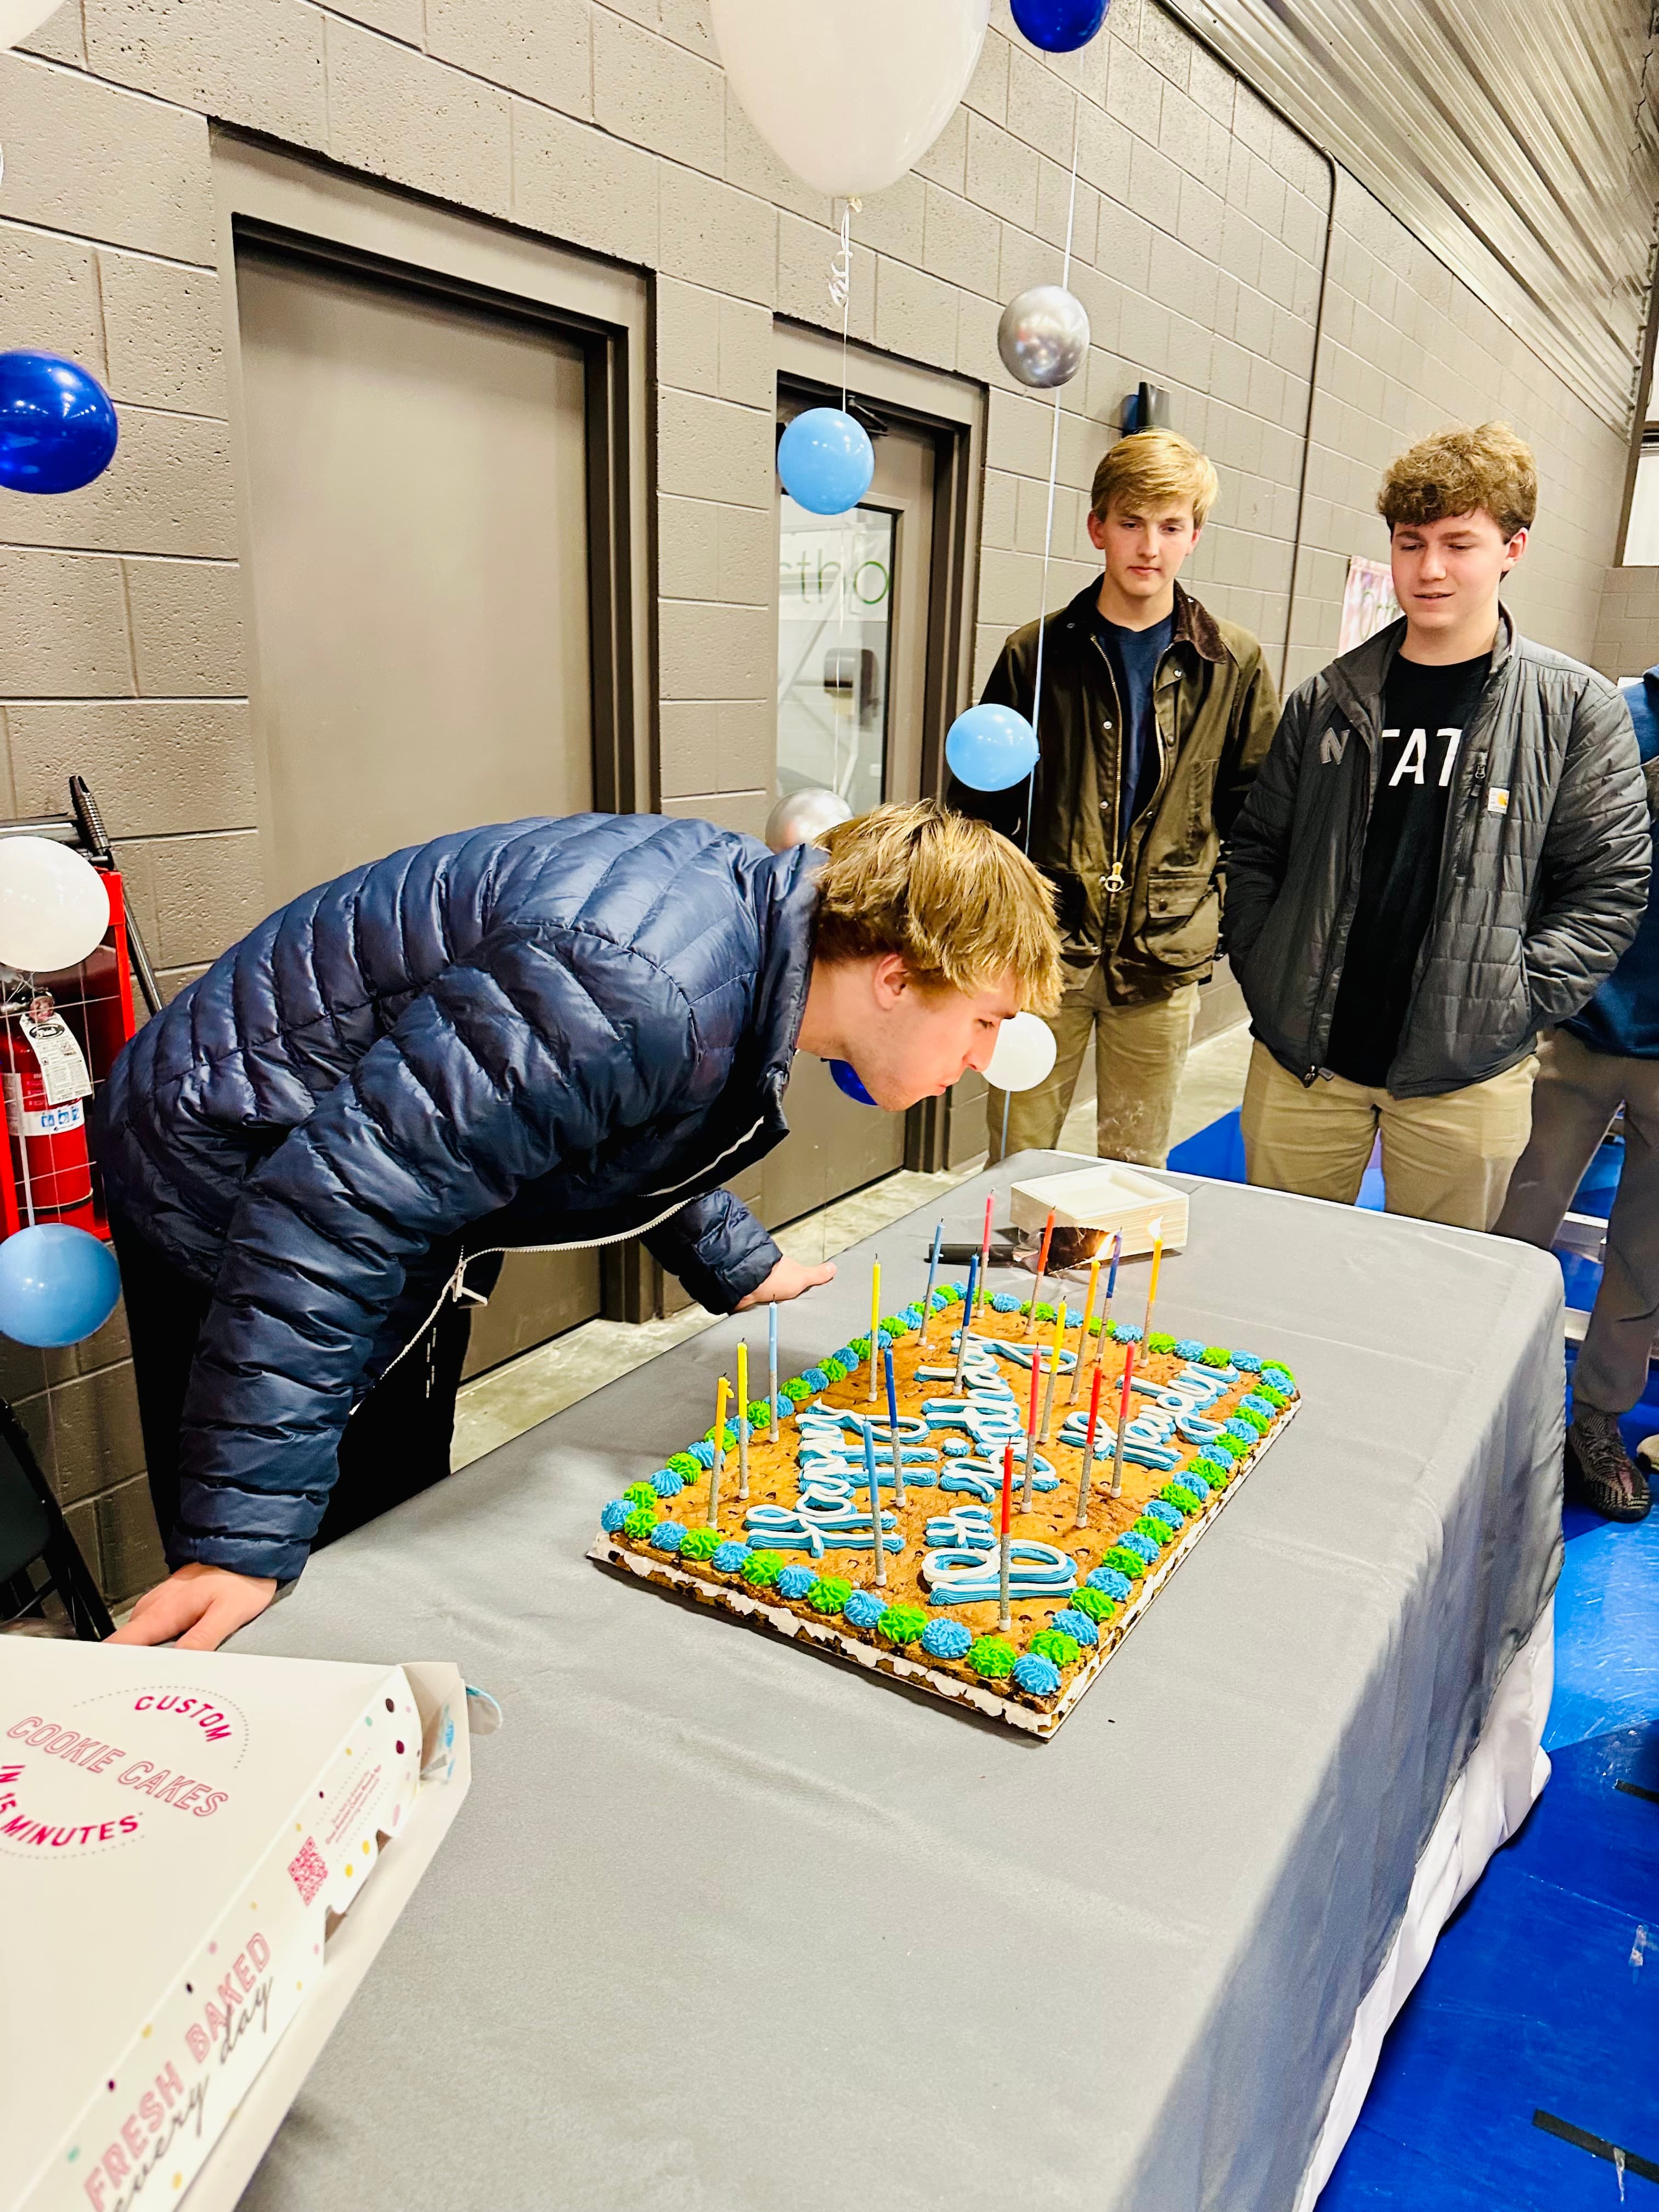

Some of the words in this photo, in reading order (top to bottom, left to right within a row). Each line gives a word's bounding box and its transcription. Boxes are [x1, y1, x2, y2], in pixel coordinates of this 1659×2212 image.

[1319, 727, 1350, 765] N
[913, 1328, 1079, 1504] Birthday
[1058, 1361, 1241, 1471] Hayden
[744, 1397, 939, 1559] Happy
[7, 1716, 126, 1773] COOKIE
[117, 1760, 228, 1817] CAKES
[134, 1695, 232, 1742] CUSTOM
[0, 1765, 26, 1783] IN
[0, 1814, 139, 1846] MINUTES
[84, 2061, 184, 2212] FRESH
[185, 1932, 271, 2064] BAKED
[114, 2074, 210, 2212] every
[221, 1976, 274, 2064] day
